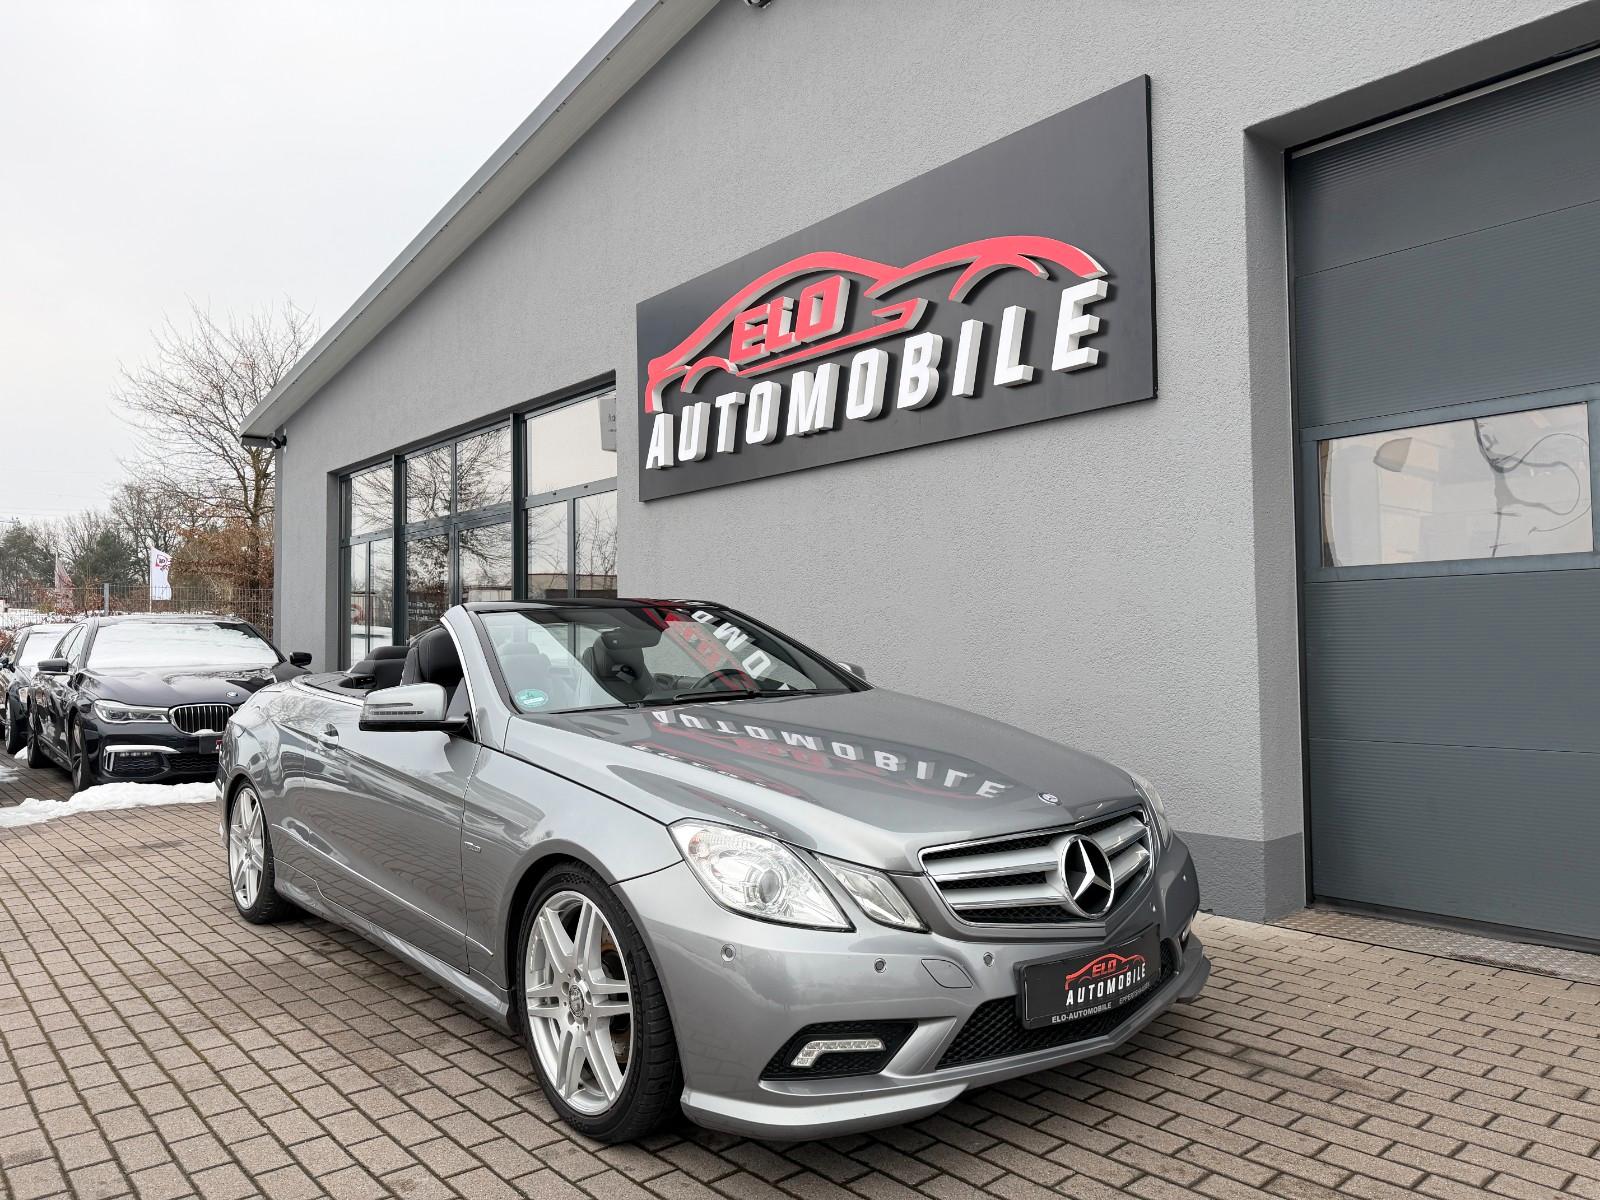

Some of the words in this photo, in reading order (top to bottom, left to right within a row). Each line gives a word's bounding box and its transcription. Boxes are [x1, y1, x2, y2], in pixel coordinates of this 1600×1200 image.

[729, 274, 851, 364] ELO
[646, 278, 1108, 470] AUTOMOBILE
[1066, 962, 1146, 1006] AUTOMOBILE
[1092, 959, 1117, 977] ELO
[1051, 1001, 1112, 1024] ELO-AUTOMOBILE
